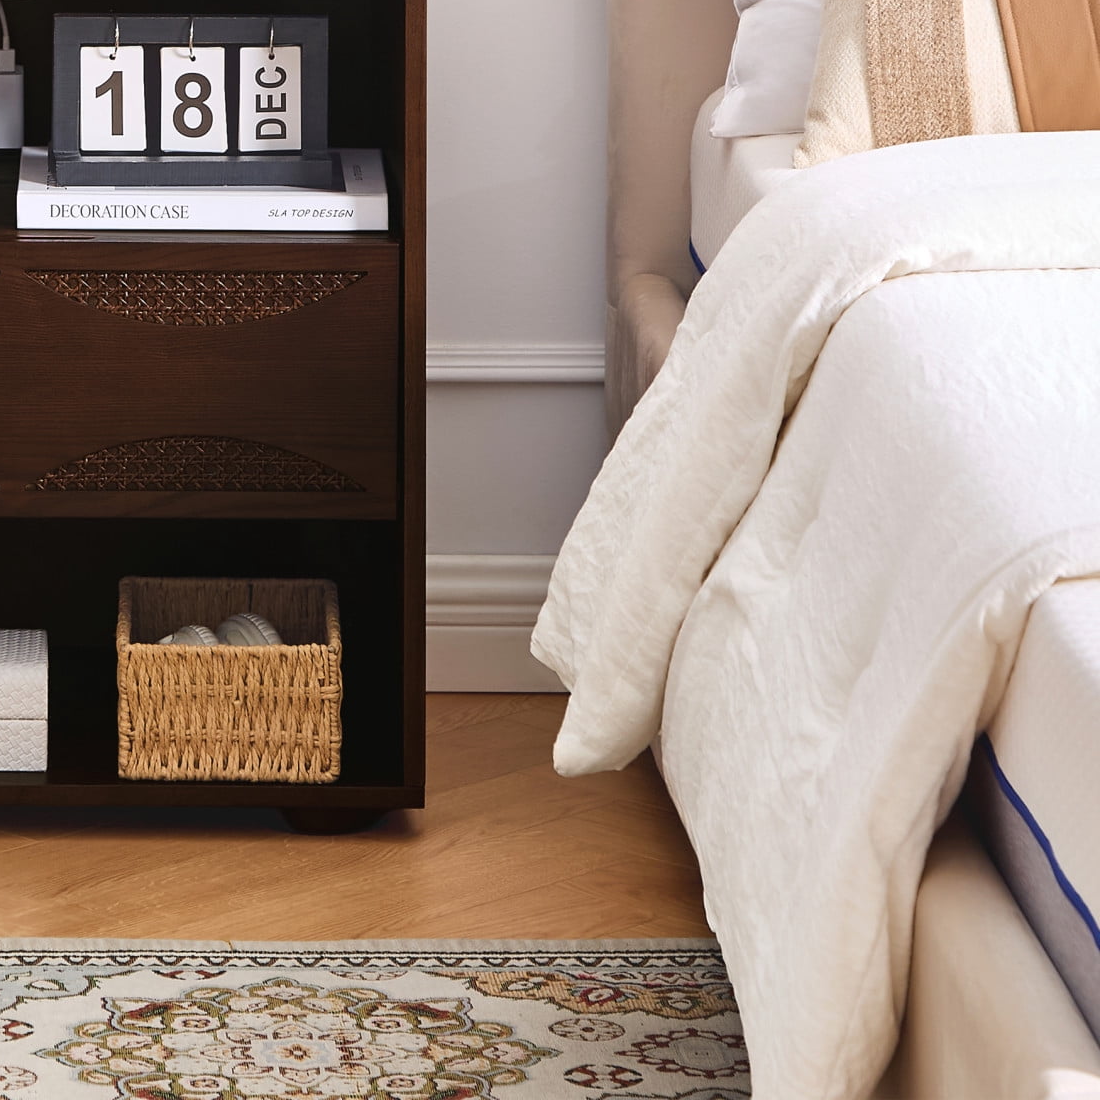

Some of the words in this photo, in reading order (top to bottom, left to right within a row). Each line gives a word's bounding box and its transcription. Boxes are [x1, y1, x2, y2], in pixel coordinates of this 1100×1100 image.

[95, 70, 124, 136] 1
[172, 72, 214, 138] 8
[254, 65, 287, 141] DEC
[50, 204, 147, 219] DECORATION
[150, 205, 190, 219] CASE
[267, 208, 288, 218] SLA
[291, 208, 311, 218] TOP
[312, 208, 354, 218] DESIGN
